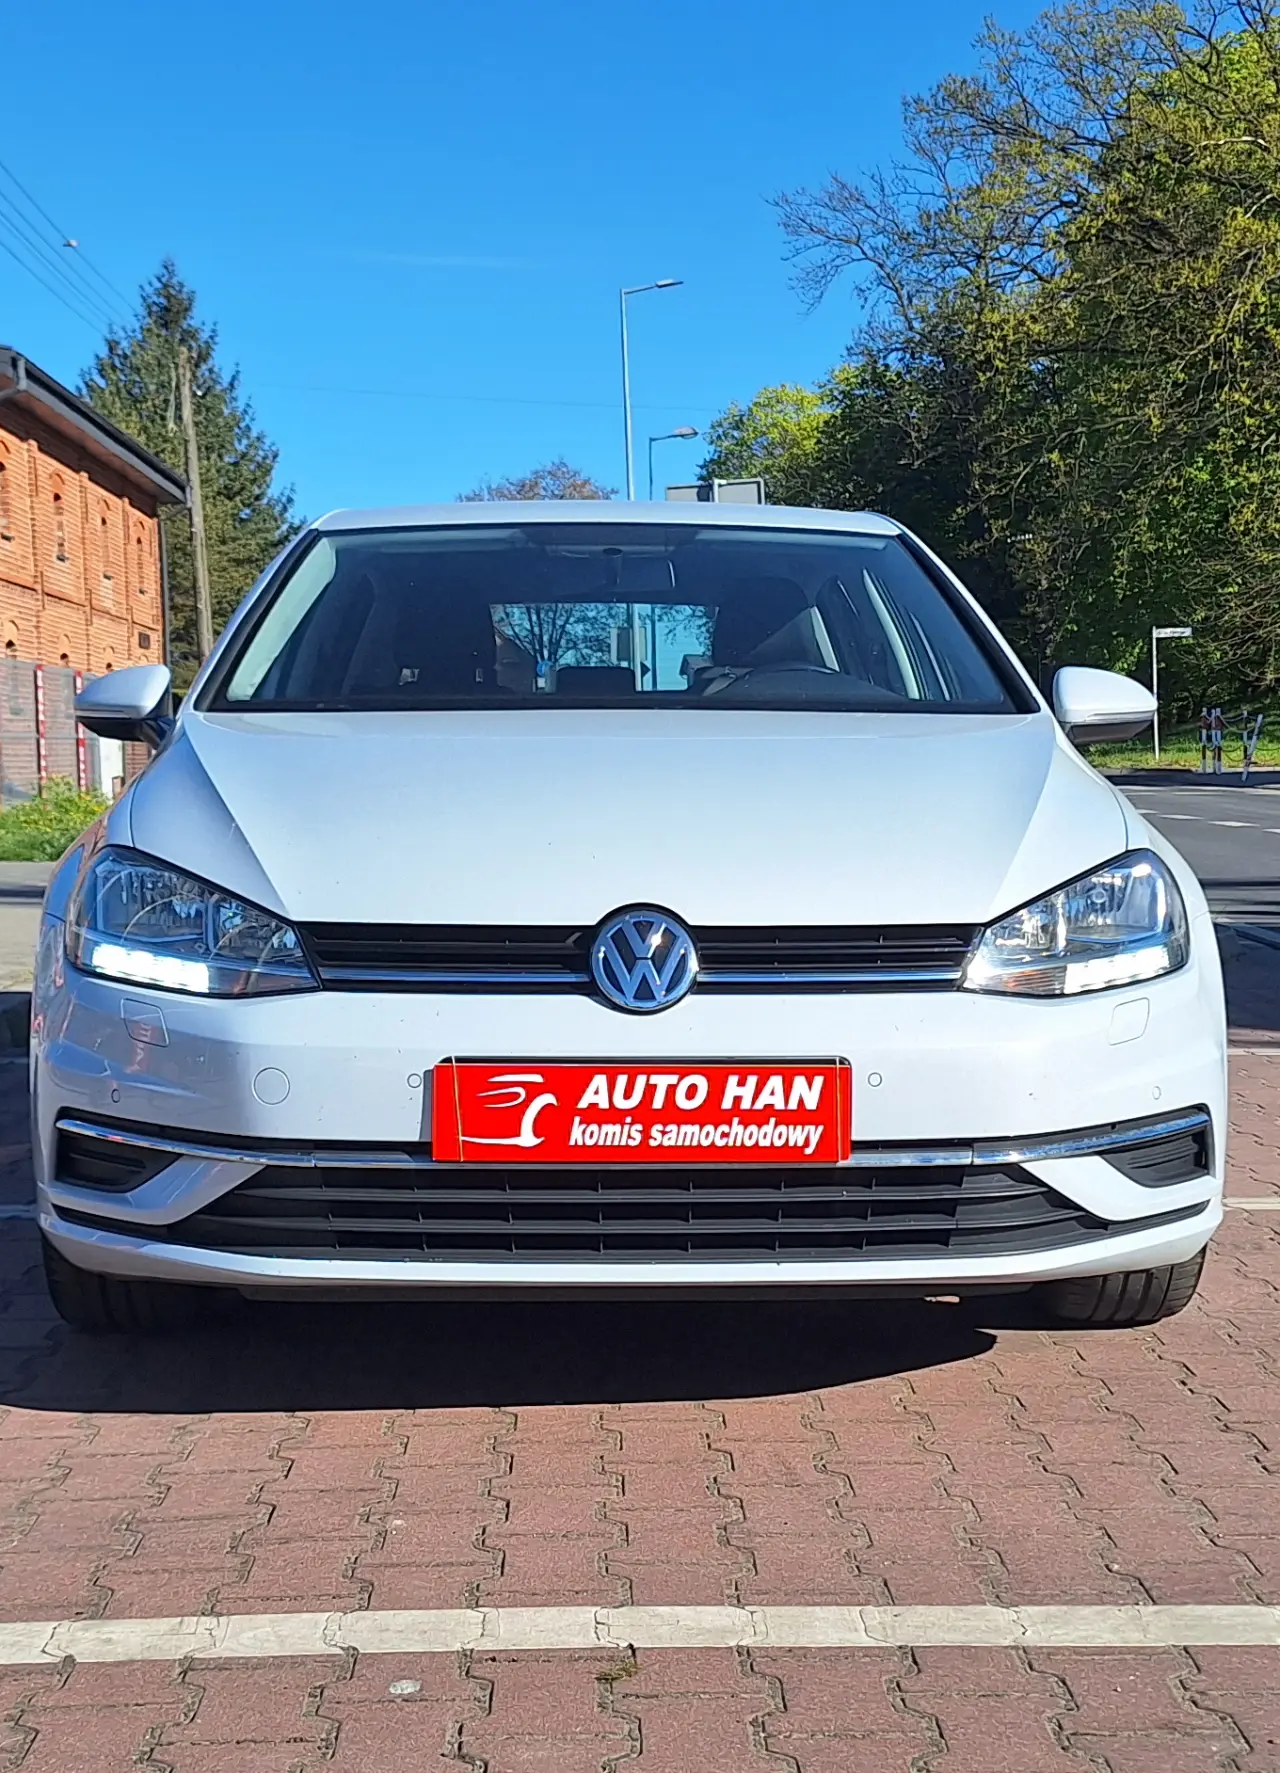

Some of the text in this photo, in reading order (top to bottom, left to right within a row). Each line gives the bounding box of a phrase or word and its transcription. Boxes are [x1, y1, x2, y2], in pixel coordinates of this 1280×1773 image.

[576, 1074, 825, 1110] AUTO HAN
[569, 1115, 825, 1155] komis samochodowy
